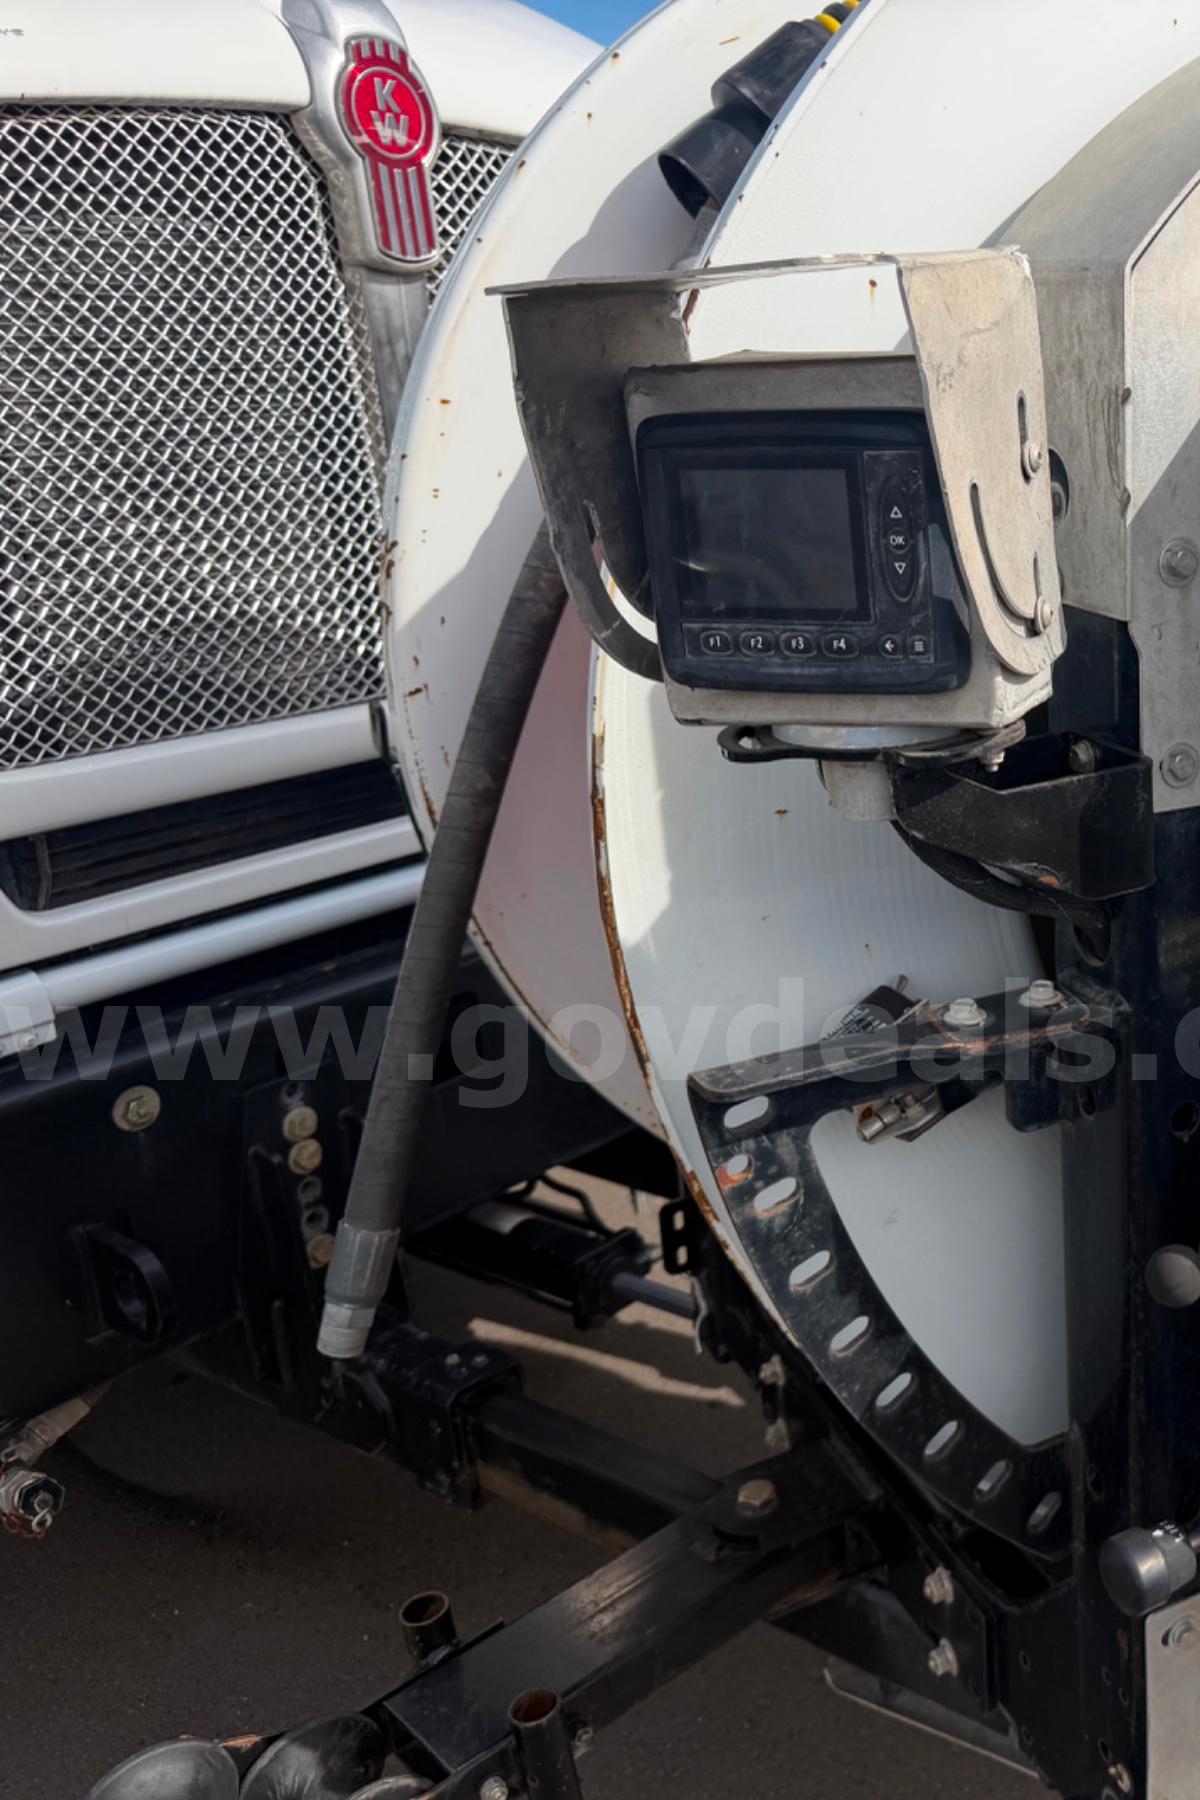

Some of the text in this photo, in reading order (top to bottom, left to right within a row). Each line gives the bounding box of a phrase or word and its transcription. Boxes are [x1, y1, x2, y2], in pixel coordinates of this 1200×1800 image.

[374, 77, 401, 113] K
[370, 110, 409, 147] W
[890, 535, 905, 545] OK
[709, 636, 722, 648] F1
[750, 637, 764, 650] F2
[791, 637, 805, 650] F3
[833, 638, 847, 651] F4
